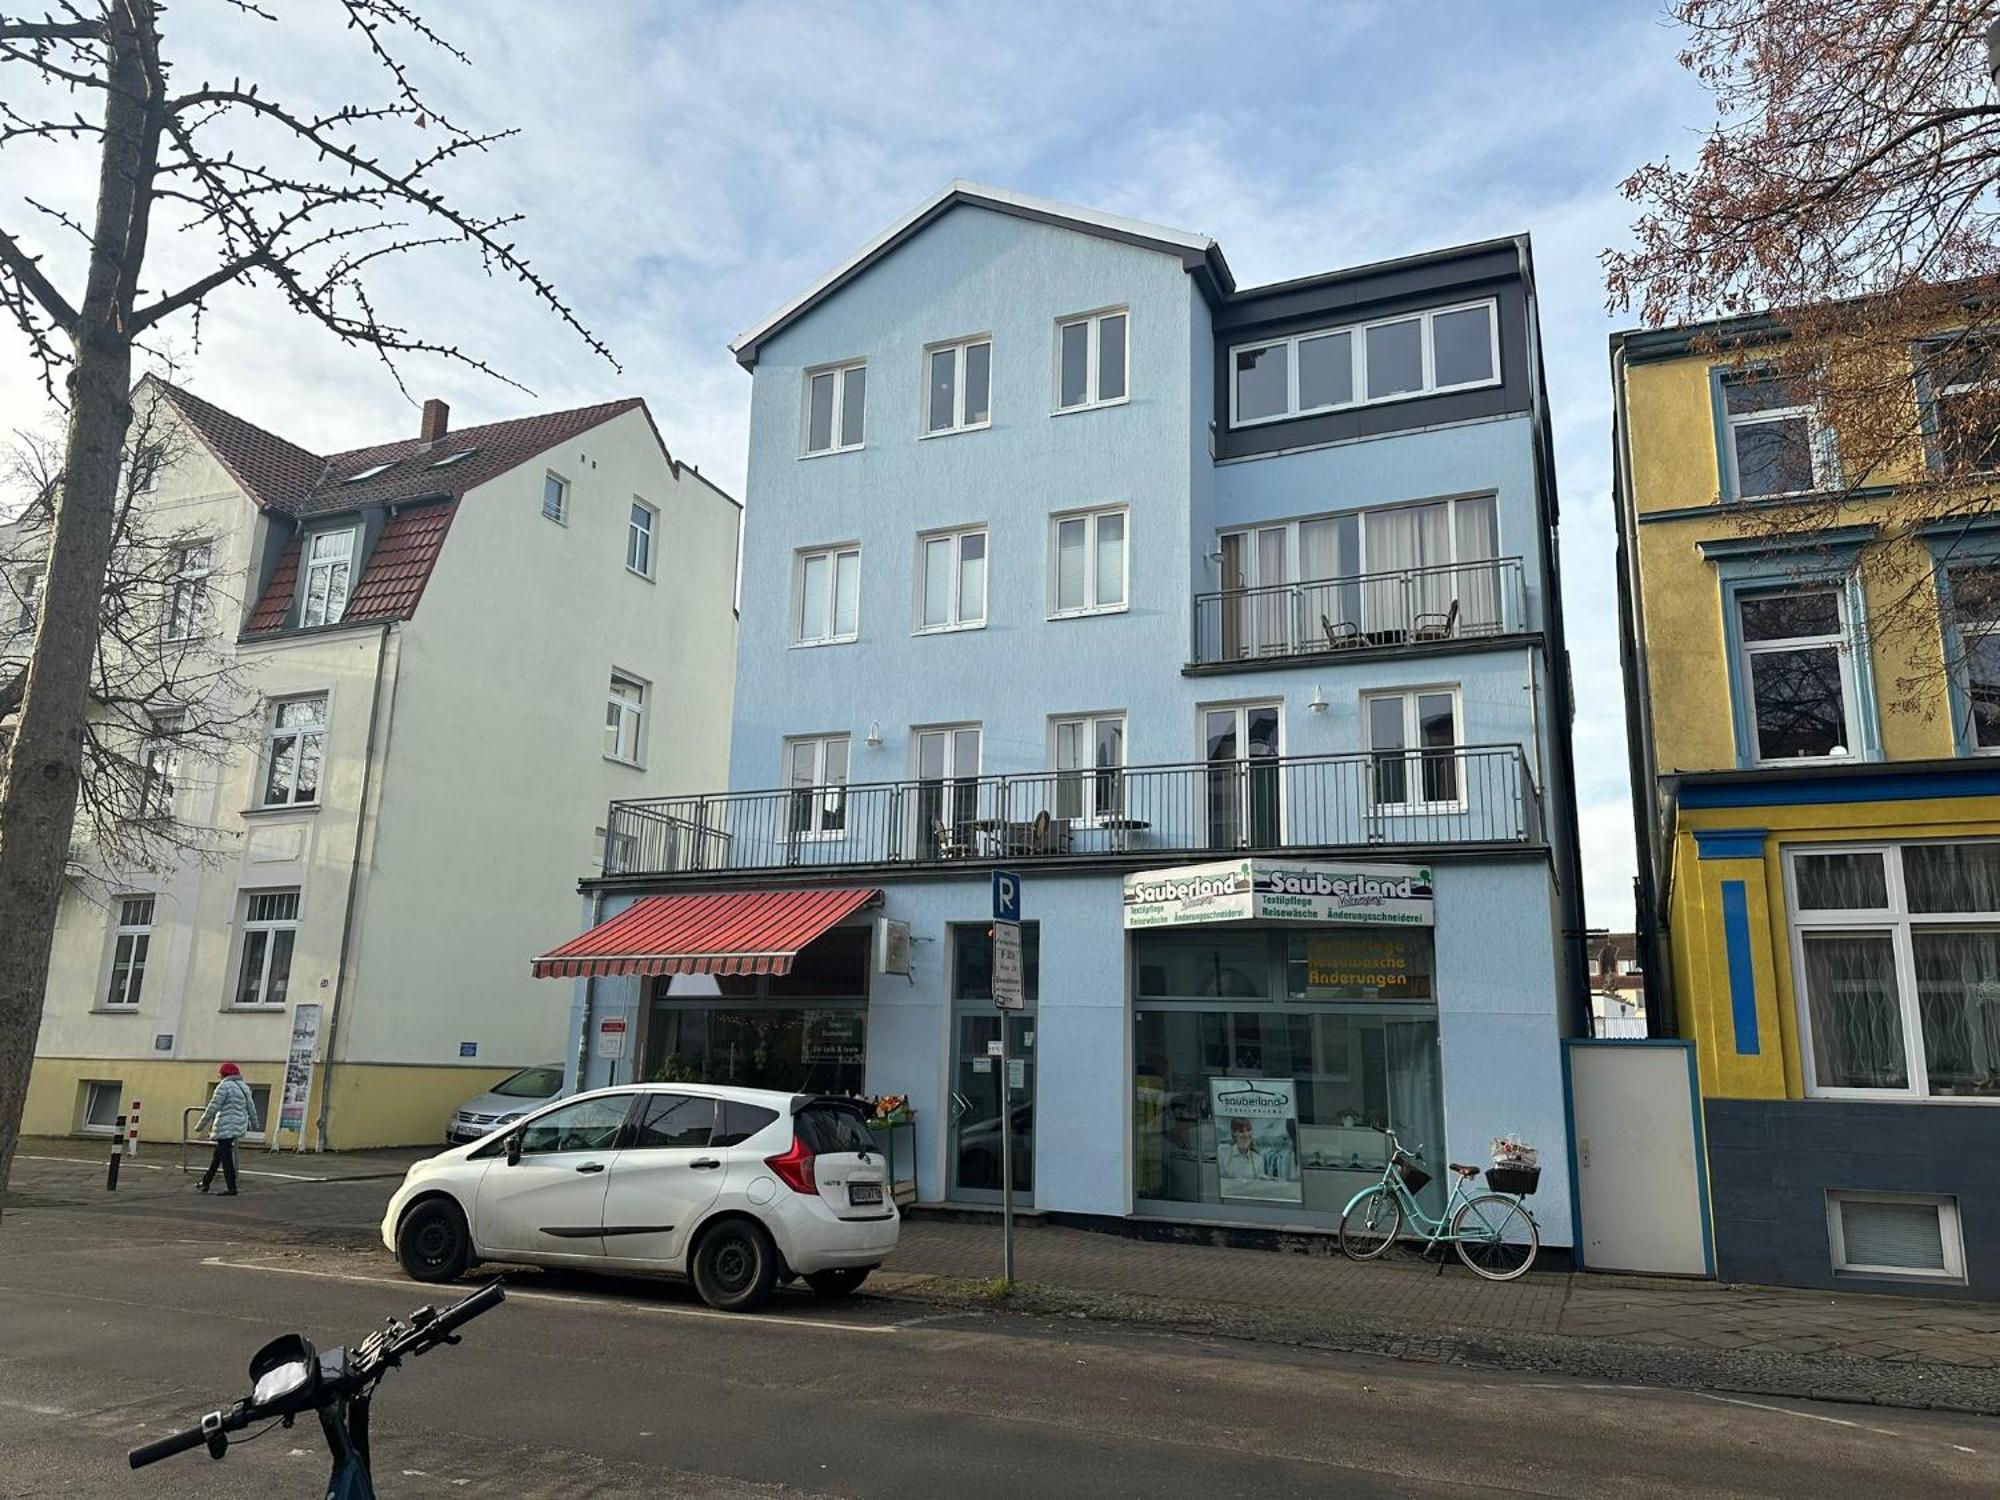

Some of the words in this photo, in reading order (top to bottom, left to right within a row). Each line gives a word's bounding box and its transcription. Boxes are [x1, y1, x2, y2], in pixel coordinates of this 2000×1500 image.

[1134, 871, 1236, 904] Sauberland
[1270, 871, 1412, 898] Sauberland
[1262, 895, 1312, 907] Textilpflege
[1262, 907, 1318, 919] Reisewäsche
[1327, 907, 1423, 923] Änderungsschneiderei
